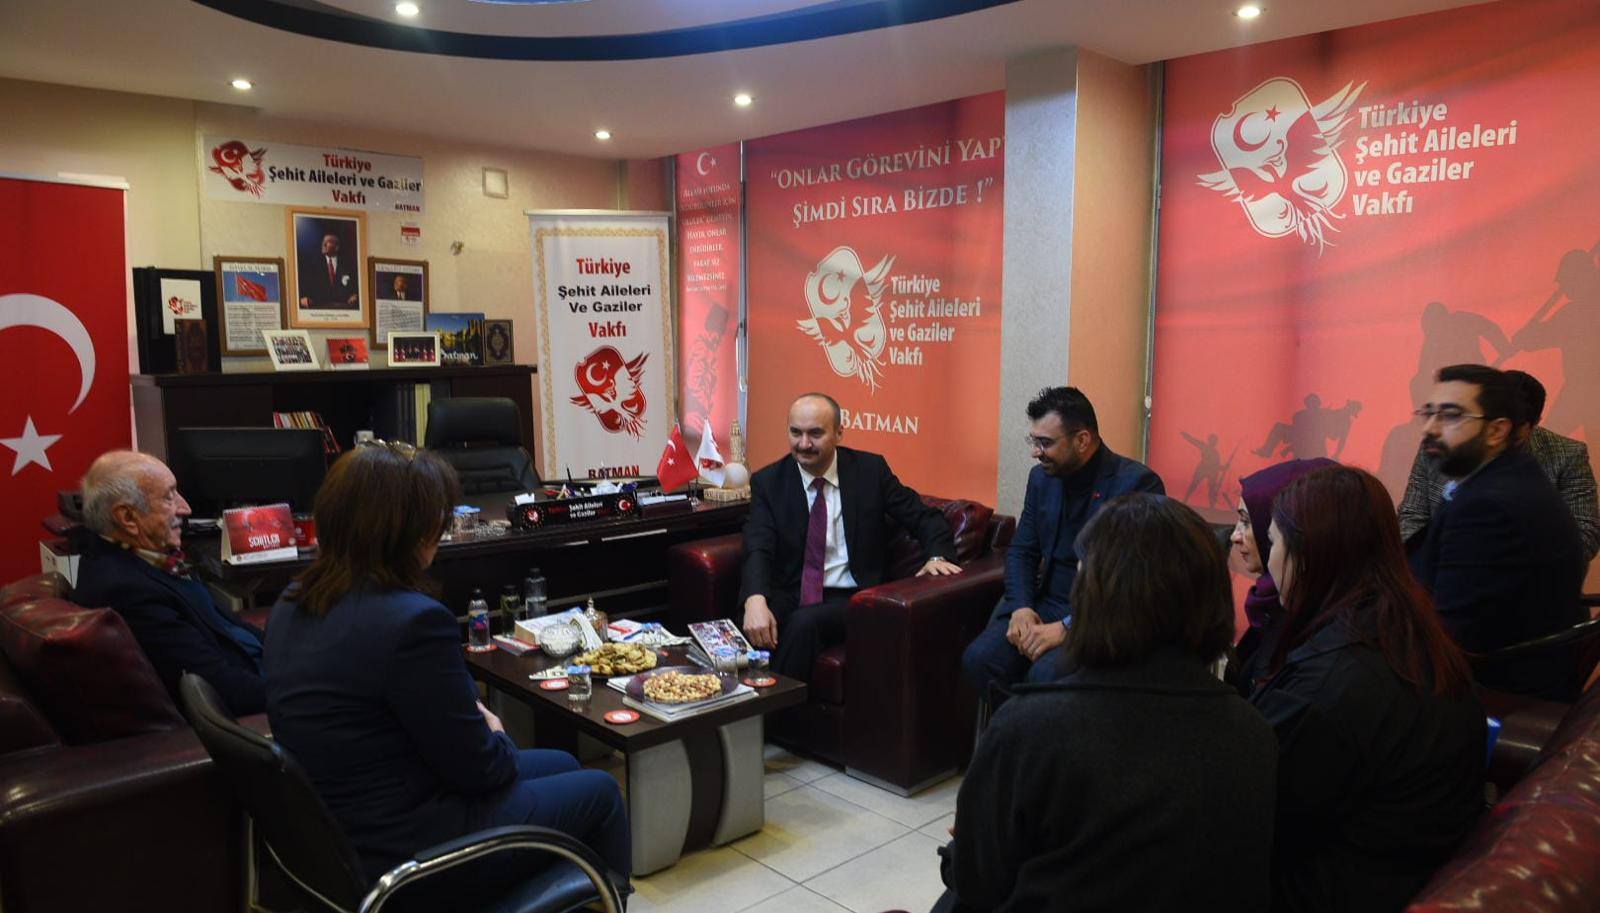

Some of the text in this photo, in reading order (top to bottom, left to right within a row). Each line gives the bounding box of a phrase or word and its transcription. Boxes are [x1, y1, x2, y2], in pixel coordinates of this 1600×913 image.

[1358, 100, 1448, 129] Türkiye
[1355, 119, 1518, 165] Şehit Aileleri
[322, 153, 372, 172] Türkiye
[846, 141, 951, 180] GÖREVİNİ
[957, 136, 1005, 162] YAP
[268, 166, 422, 192] Şehit Aileleri ve Gaziler
[1354, 157, 1475, 187] ve Gaziler
[332, 189, 366, 204] Vakfı
[792, 196, 847, 228] ŞİMDİ
[851, 195, 897, 217] SIRA
[903, 186, 968, 211] BİZDE
[1352, 190, 1413, 216] Vakfı
[576, 258, 631, 278] Türkiye
[558, 284, 651, 300] Şehit Aileleri
[890, 274, 941, 297] Türkiye
[569, 301, 642, 313] Ve Gaziler
[889, 296, 981, 323] Şehit Aileleri
[588, 320, 627, 338] Vakfı
[889, 322, 955, 342] ve Gaziler
[889, 346, 923, 366] Vakfı
[840, 408, 920, 435] BATMAN
